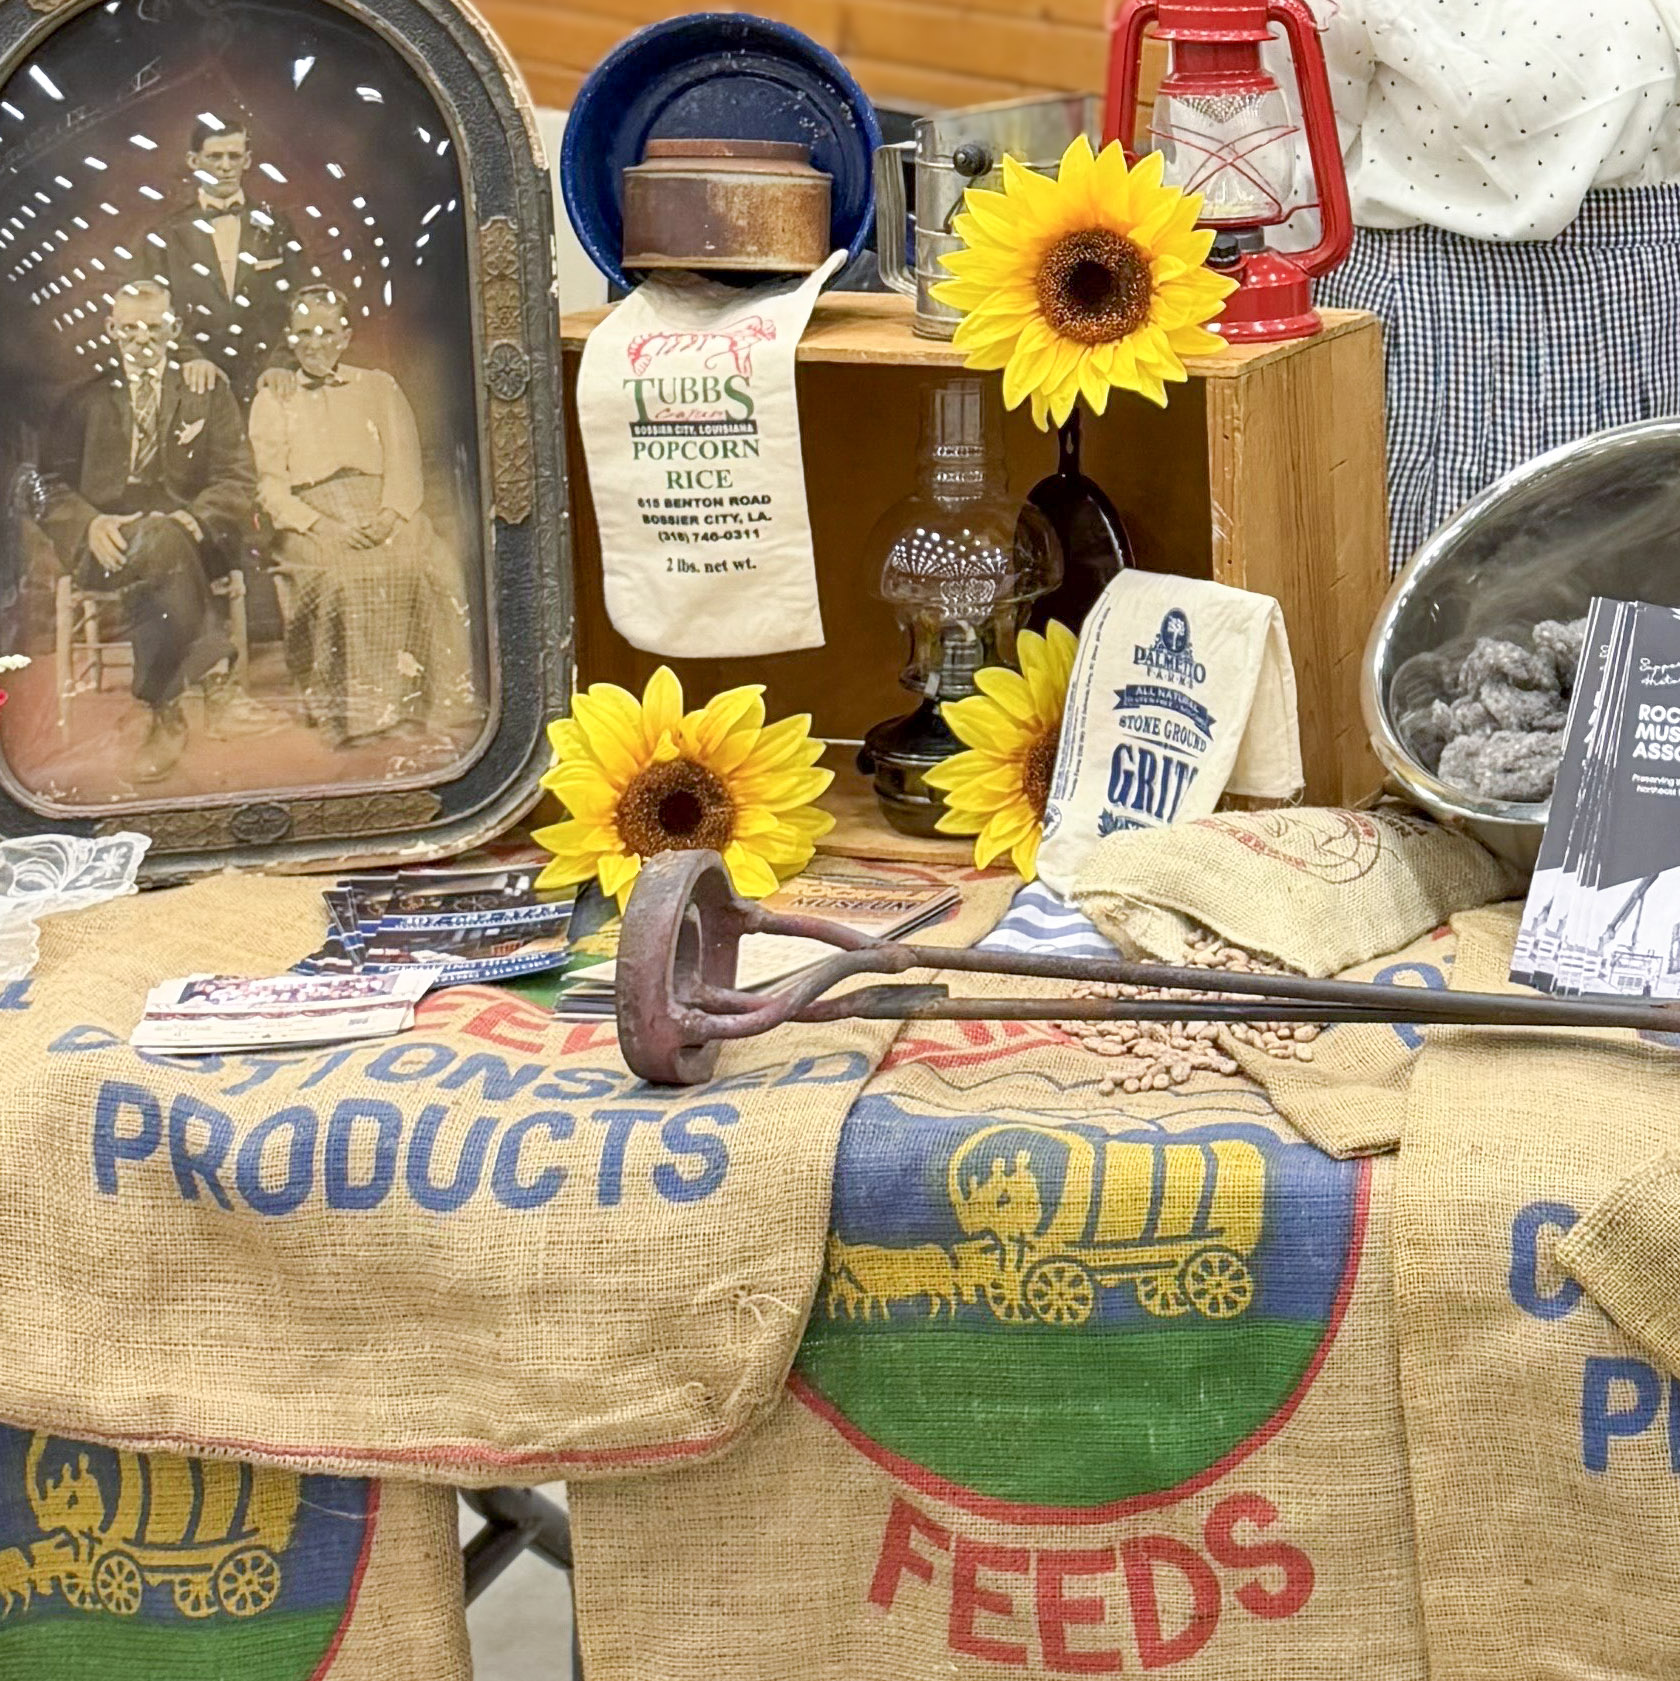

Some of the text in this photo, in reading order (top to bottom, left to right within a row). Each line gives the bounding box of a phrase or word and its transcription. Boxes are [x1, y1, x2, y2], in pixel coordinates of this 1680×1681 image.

[623, 374, 755, 422] TUBBS
[698, 423, 754, 435] LOUISIANA
[632, 438, 760, 460] POPCORN
[666, 469, 733, 490] RICE
[664, 495, 724, 509] BENTON
[729, 494, 772, 506] ROAD
[642, 514, 700, 526] BOSSIER
[747, 511, 772, 522] LA.
[666, 557, 757, 573] 2 lbs. net wt.
[1119, 715, 1207, 753] STONE GROUND
[91, 1078, 742, 1216] PRODUCTS
[867, 1491, 1315, 1674] FEEDS
